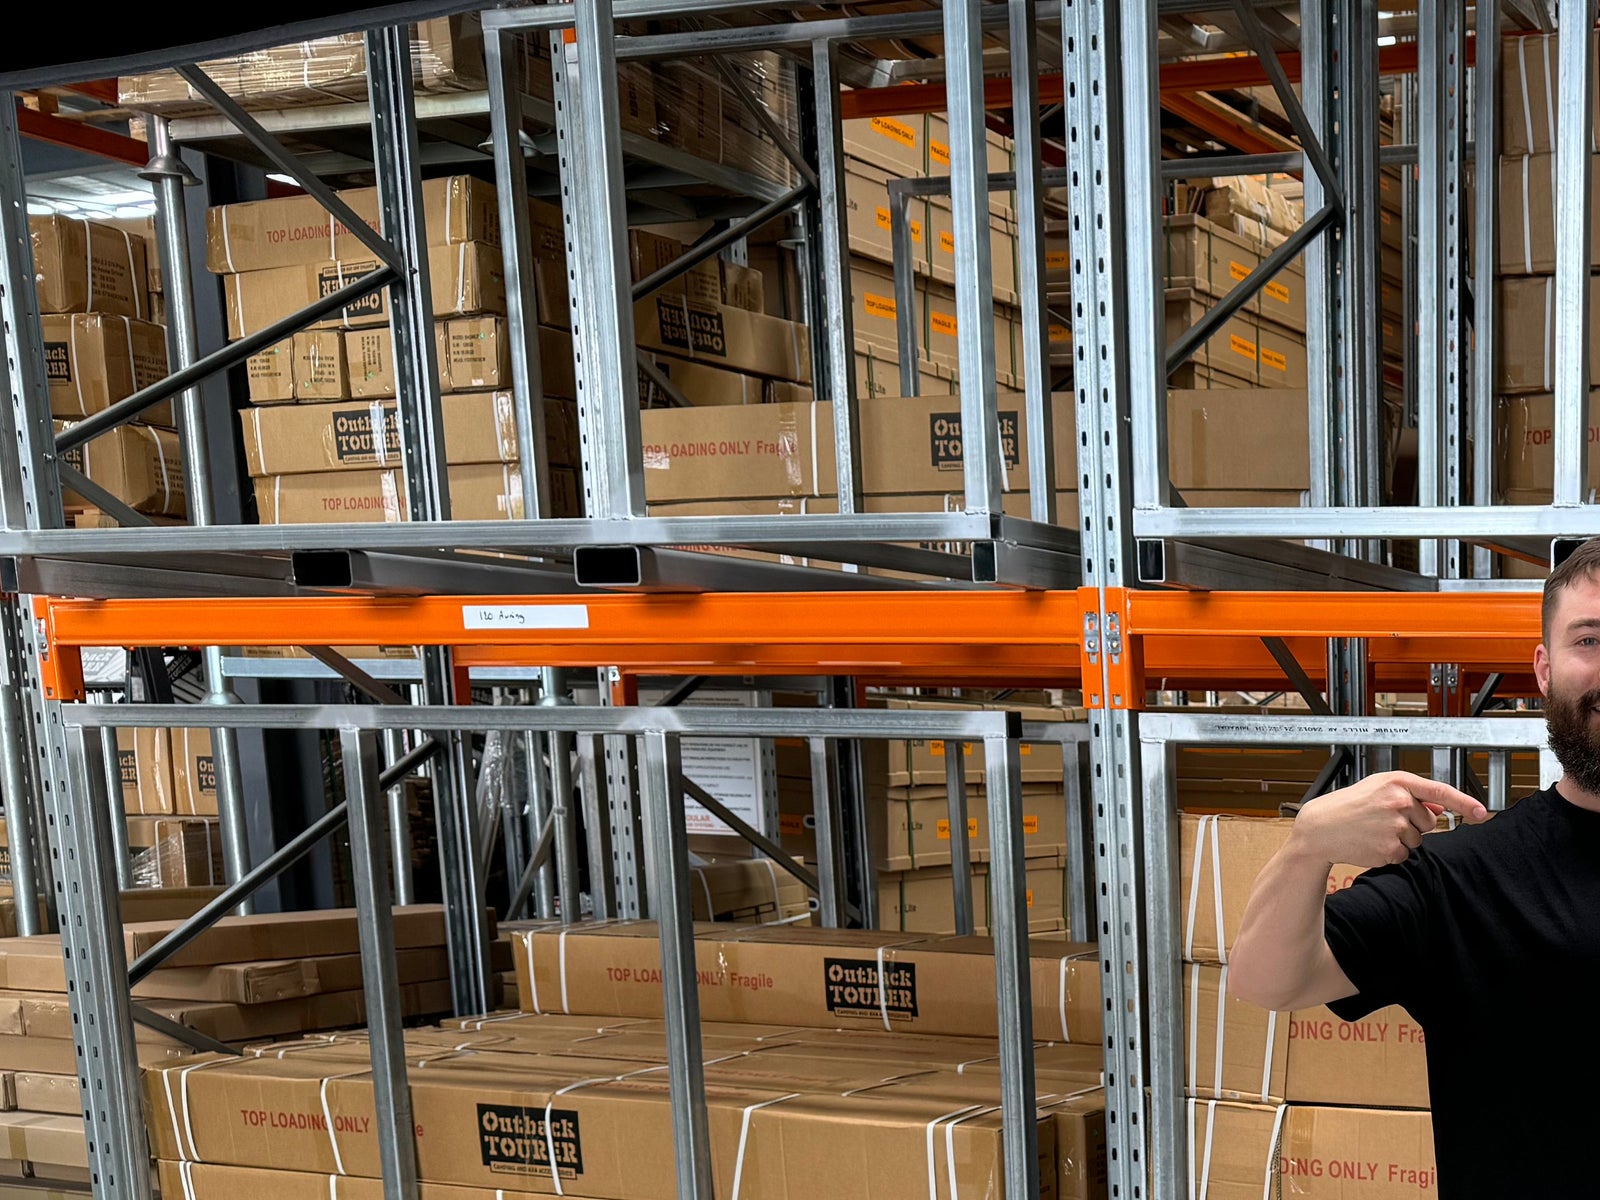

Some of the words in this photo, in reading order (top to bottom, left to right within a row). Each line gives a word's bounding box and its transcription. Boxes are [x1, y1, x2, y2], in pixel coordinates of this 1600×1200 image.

[266, 230, 286, 244] TOP
[663, 442, 717, 458] LOADING
[719, 440, 750, 455] ONLY
[321, 498, 342, 511] TOP
[606, 967, 631, 982] TOP
[731, 972, 773, 991] Fragile
[1338, 1022, 1388, 1042] ONLY
[1398, 1024, 1425, 1043] Fra
[241, 1109, 267, 1126] TOP
[271, 1111, 327, 1132] LOADING
[335, 1114, 369, 1134] ONLY
[1329, 1160, 1378, 1181] ONLY
[1388, 1164, 1435, 1189] Fragi
